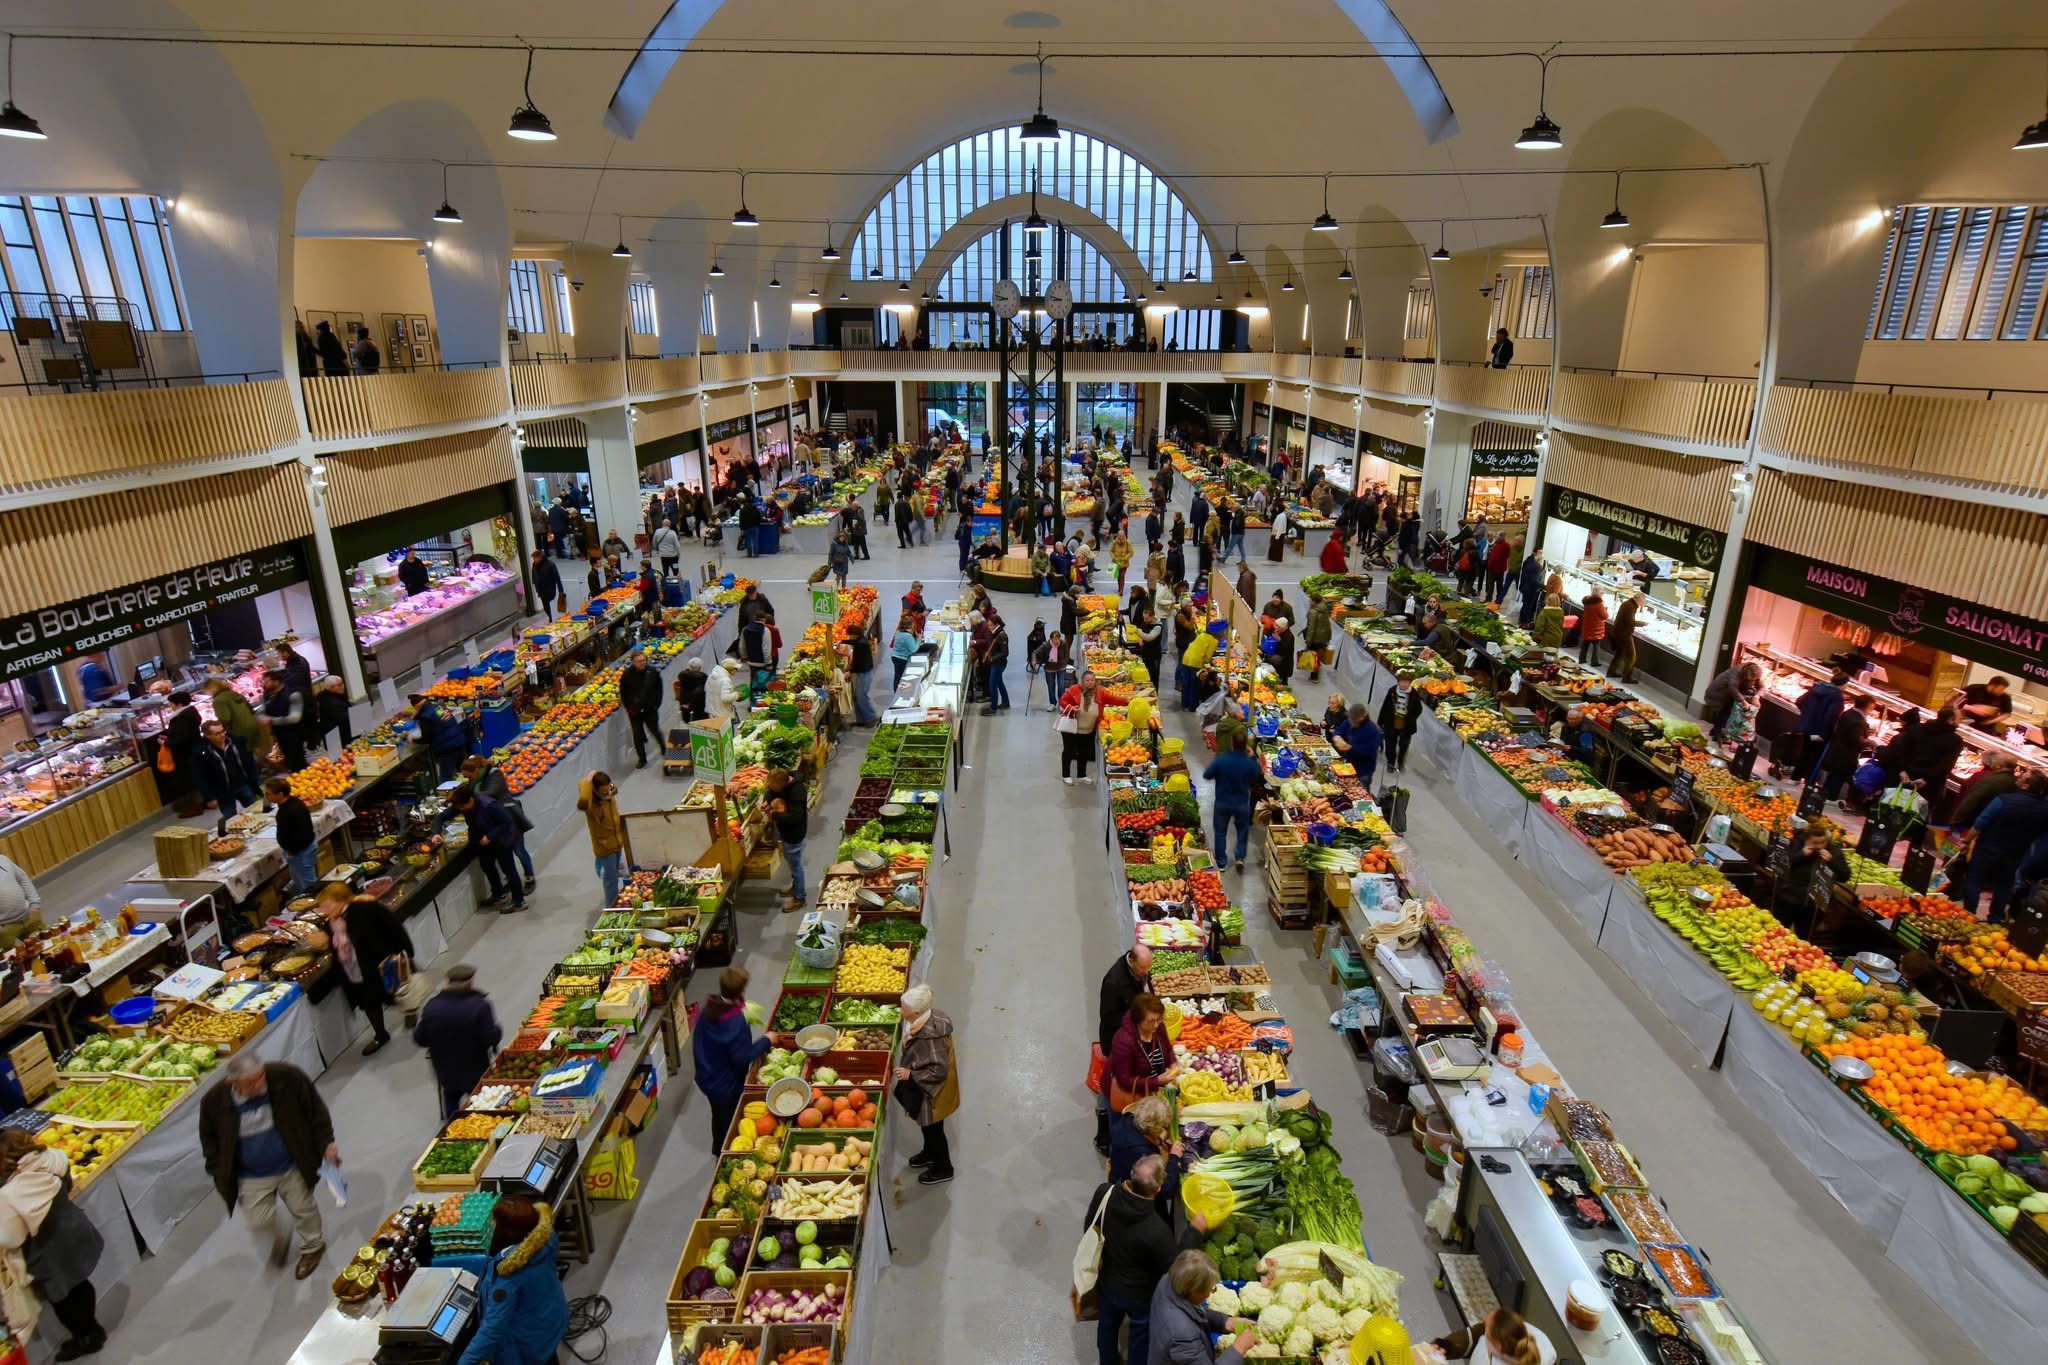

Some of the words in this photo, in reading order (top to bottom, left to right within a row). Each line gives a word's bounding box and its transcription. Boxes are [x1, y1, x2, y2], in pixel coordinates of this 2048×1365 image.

[1576, 497, 1646, 530] FROMAGERIE
[1647, 517, 1690, 544] BLANC
[38, 583, 162, 639] Boucherie
[165, 574, 192, 600] de
[193, 557, 254, 593] Fleurie
[815, 597, 831, 613] AB
[1807, 565, 1868, 598] MAISON
[1944, 606, 2048, 652] SALIGNAT
[5, 647, 63, 675] ARTISAN
[74, 623, 133, 651] BOUCHER
[144, 600, 208, 628] CHARCUTIER
[215, 583, 260, 605] TRAITEUR
[2022, 663, 2034, 673] 01
[2034, 666, 2048, 680] GU
[695, 744, 718, 769] AB
